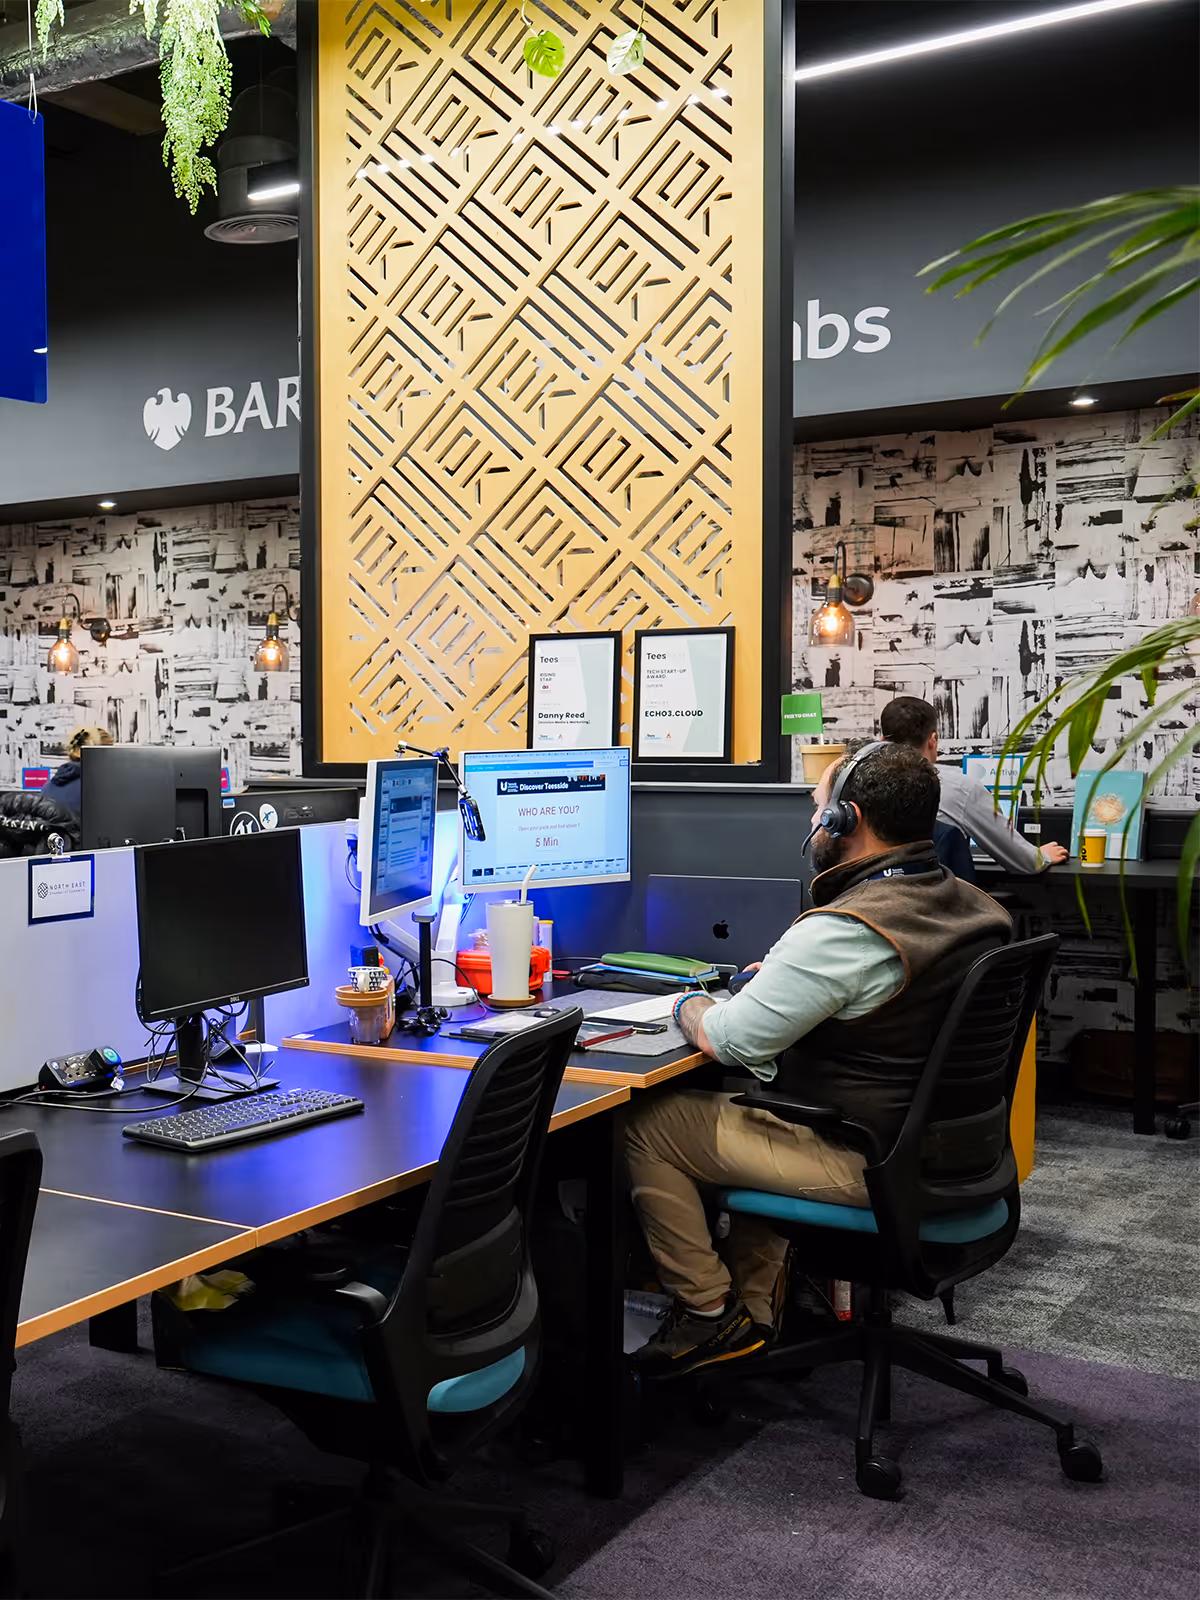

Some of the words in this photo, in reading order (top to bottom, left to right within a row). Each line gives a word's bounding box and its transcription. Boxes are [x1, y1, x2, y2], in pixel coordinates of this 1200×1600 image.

[539, 656, 559, 664] Tees
[646, 652, 667, 660] Tees
[538, 712, 564, 720] Danny
[644, 710, 704, 718] ECHO3.CLOUD
[520, 783, 544, 791] Discover
[544, 782, 569, 790] Teesside
[518, 807, 538, 817] WHO
[539, 806, 556, 815] ARE
[558, 805, 580, 814] YOU?
[535, 837, 541, 848] 5
[543, 836, 559, 847] Min
[71, 881, 85, 889] EAST
